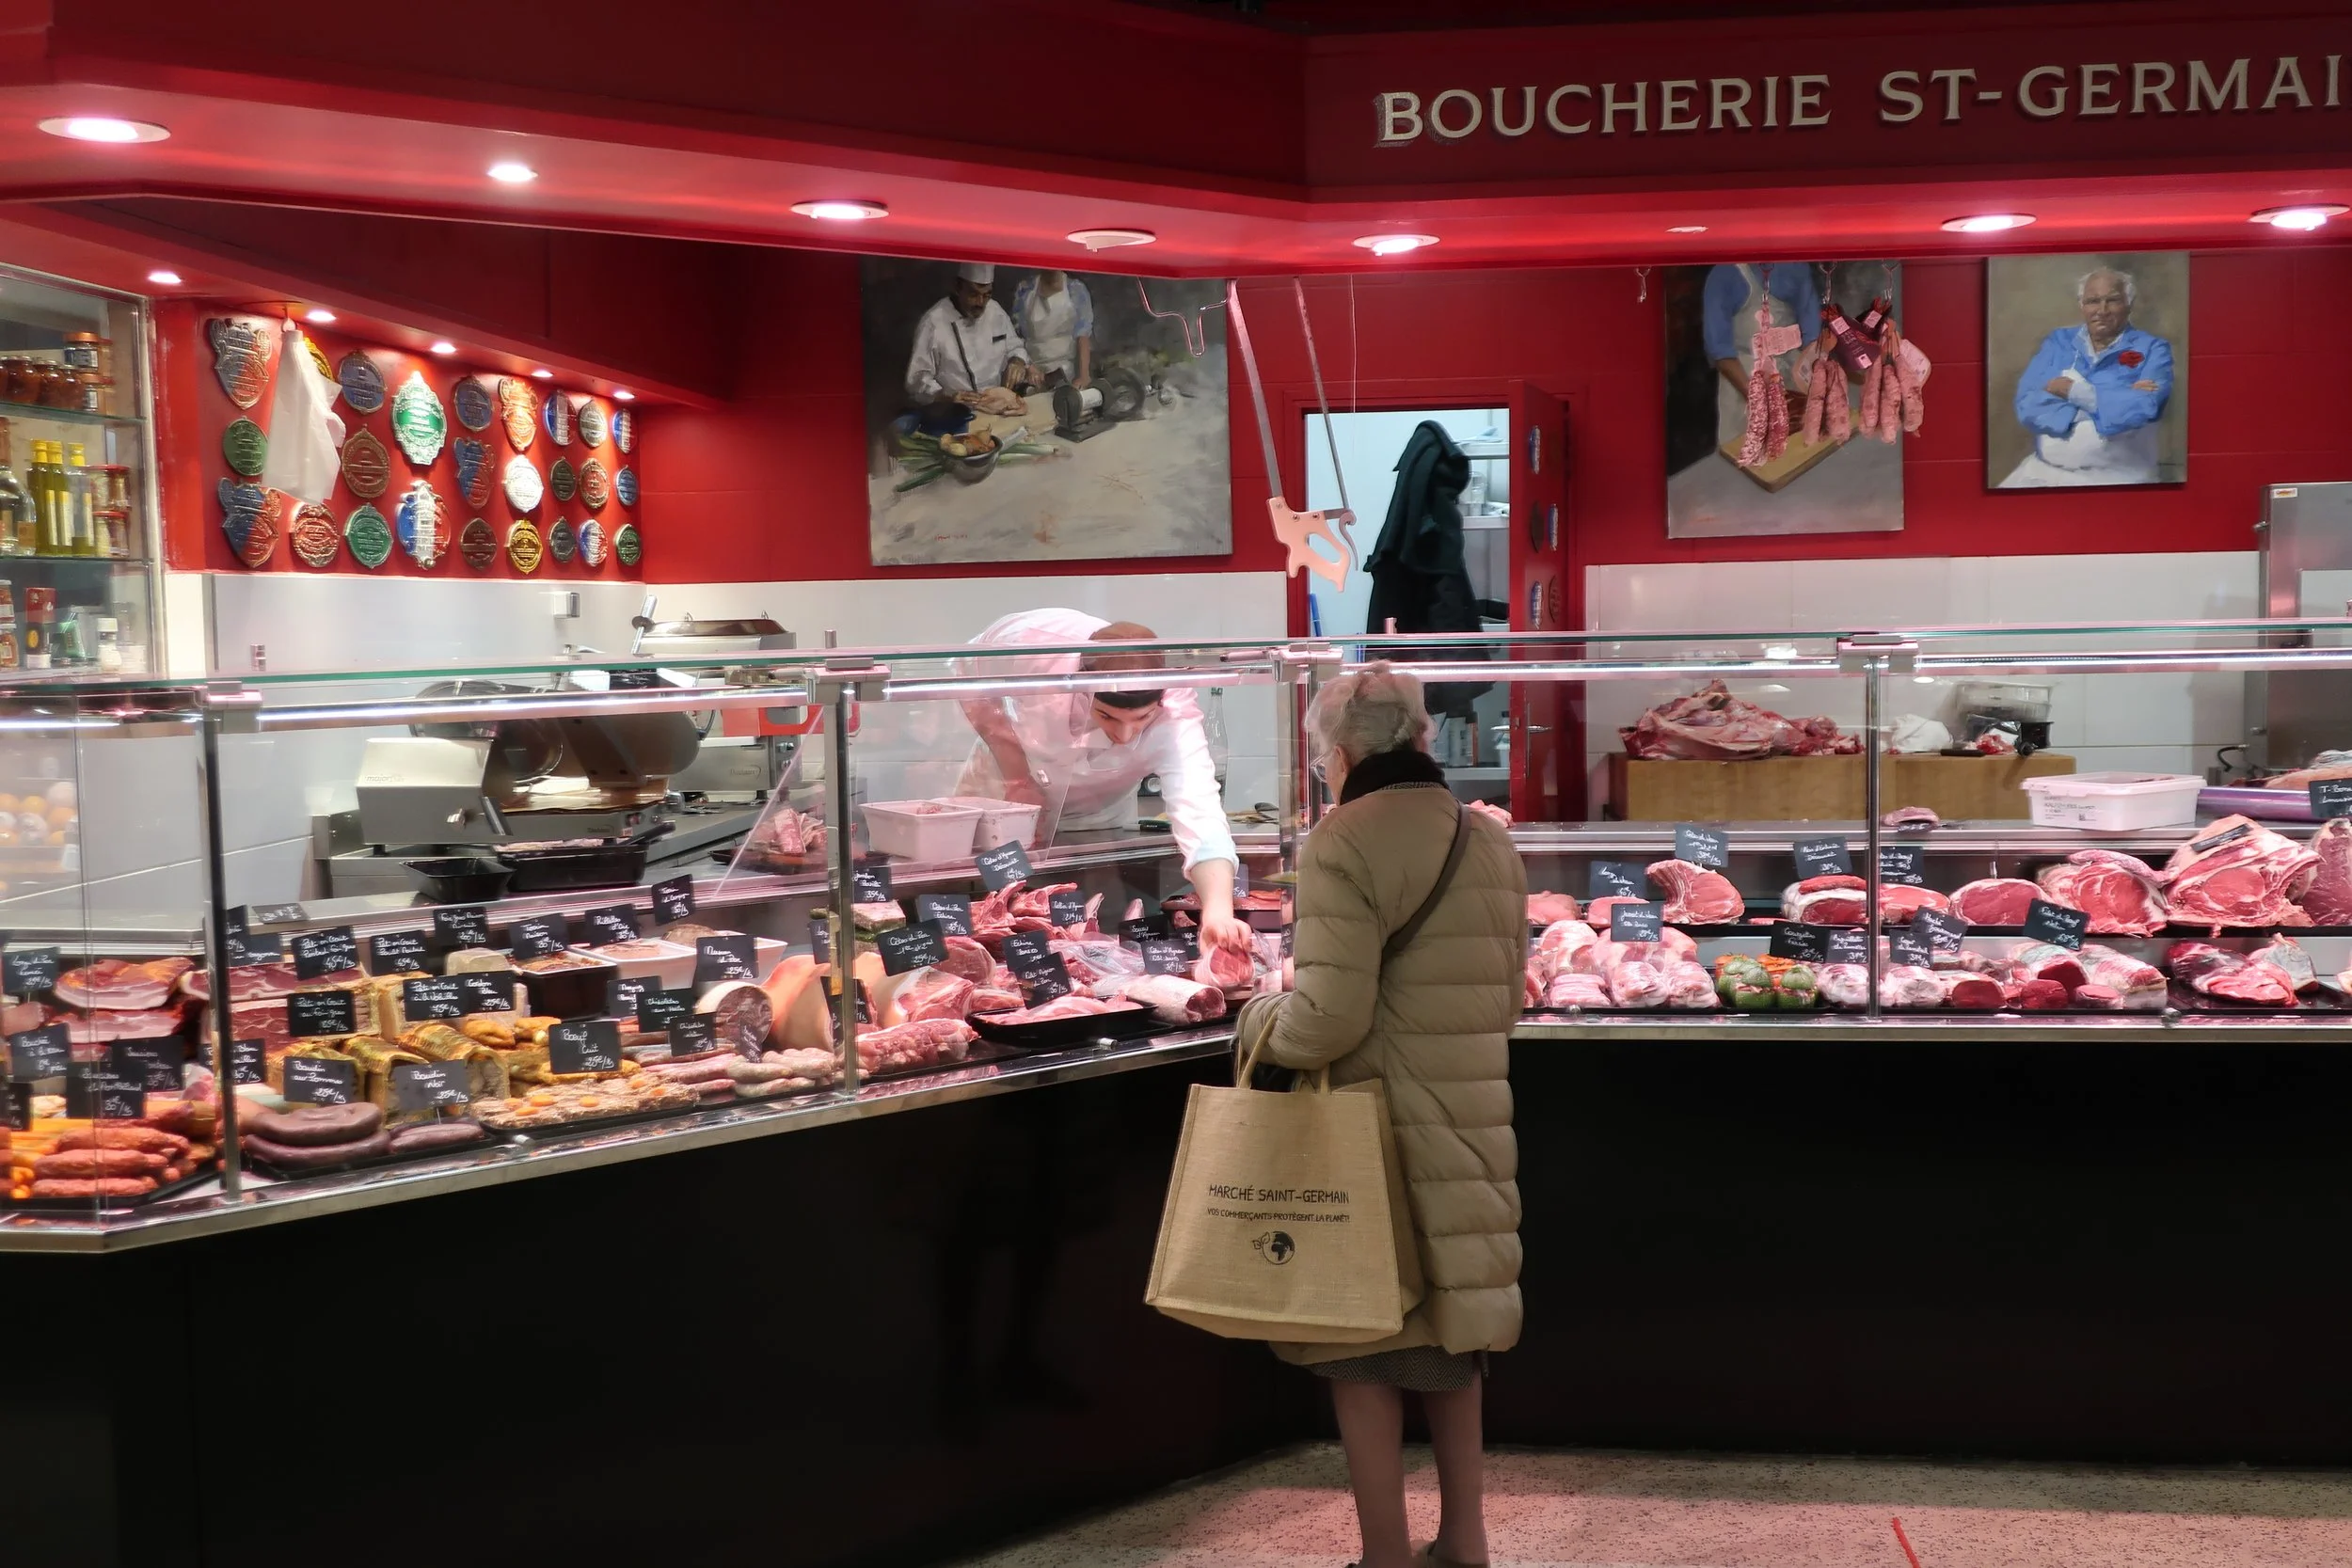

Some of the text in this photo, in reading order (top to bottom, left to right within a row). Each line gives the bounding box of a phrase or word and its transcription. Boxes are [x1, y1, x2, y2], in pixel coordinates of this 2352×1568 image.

[1379, 55, 2343, 142] BOUCHERIE ST-GERMAI
[1208, 1183, 1350, 1204] MARCHÉ SAINT-GERMAIN
[1220, 1209, 1272, 1222] COMMERÇANTS
[1273, 1211, 1314, 1222] PROTÈGENT
[1315, 1213, 1325, 1222] LA
